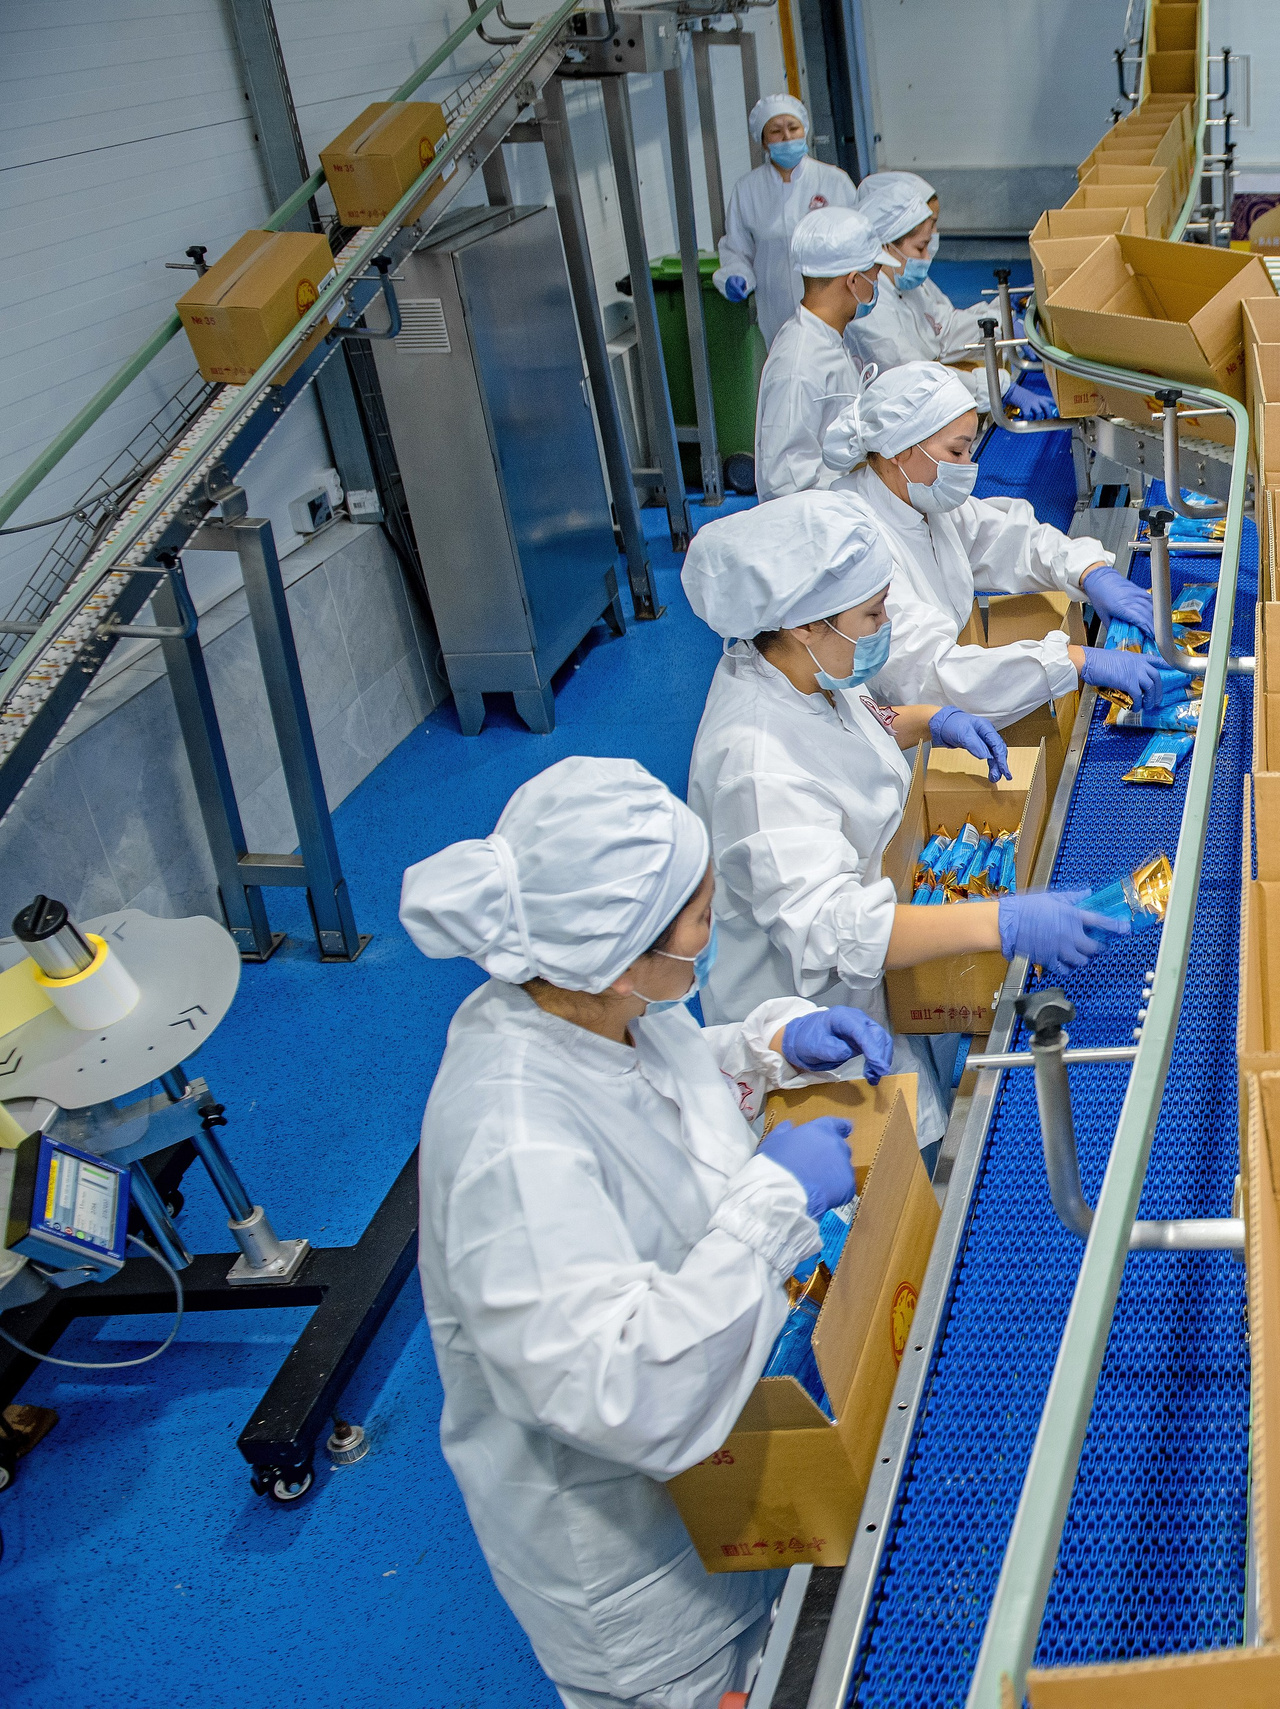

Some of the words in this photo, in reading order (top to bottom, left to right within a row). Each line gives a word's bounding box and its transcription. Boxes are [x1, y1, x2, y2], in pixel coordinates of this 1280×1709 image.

[345, 164, 354, 172] 35
[205, 317, 215, 325] 35
[711, 1450, 735, 1465] 35
